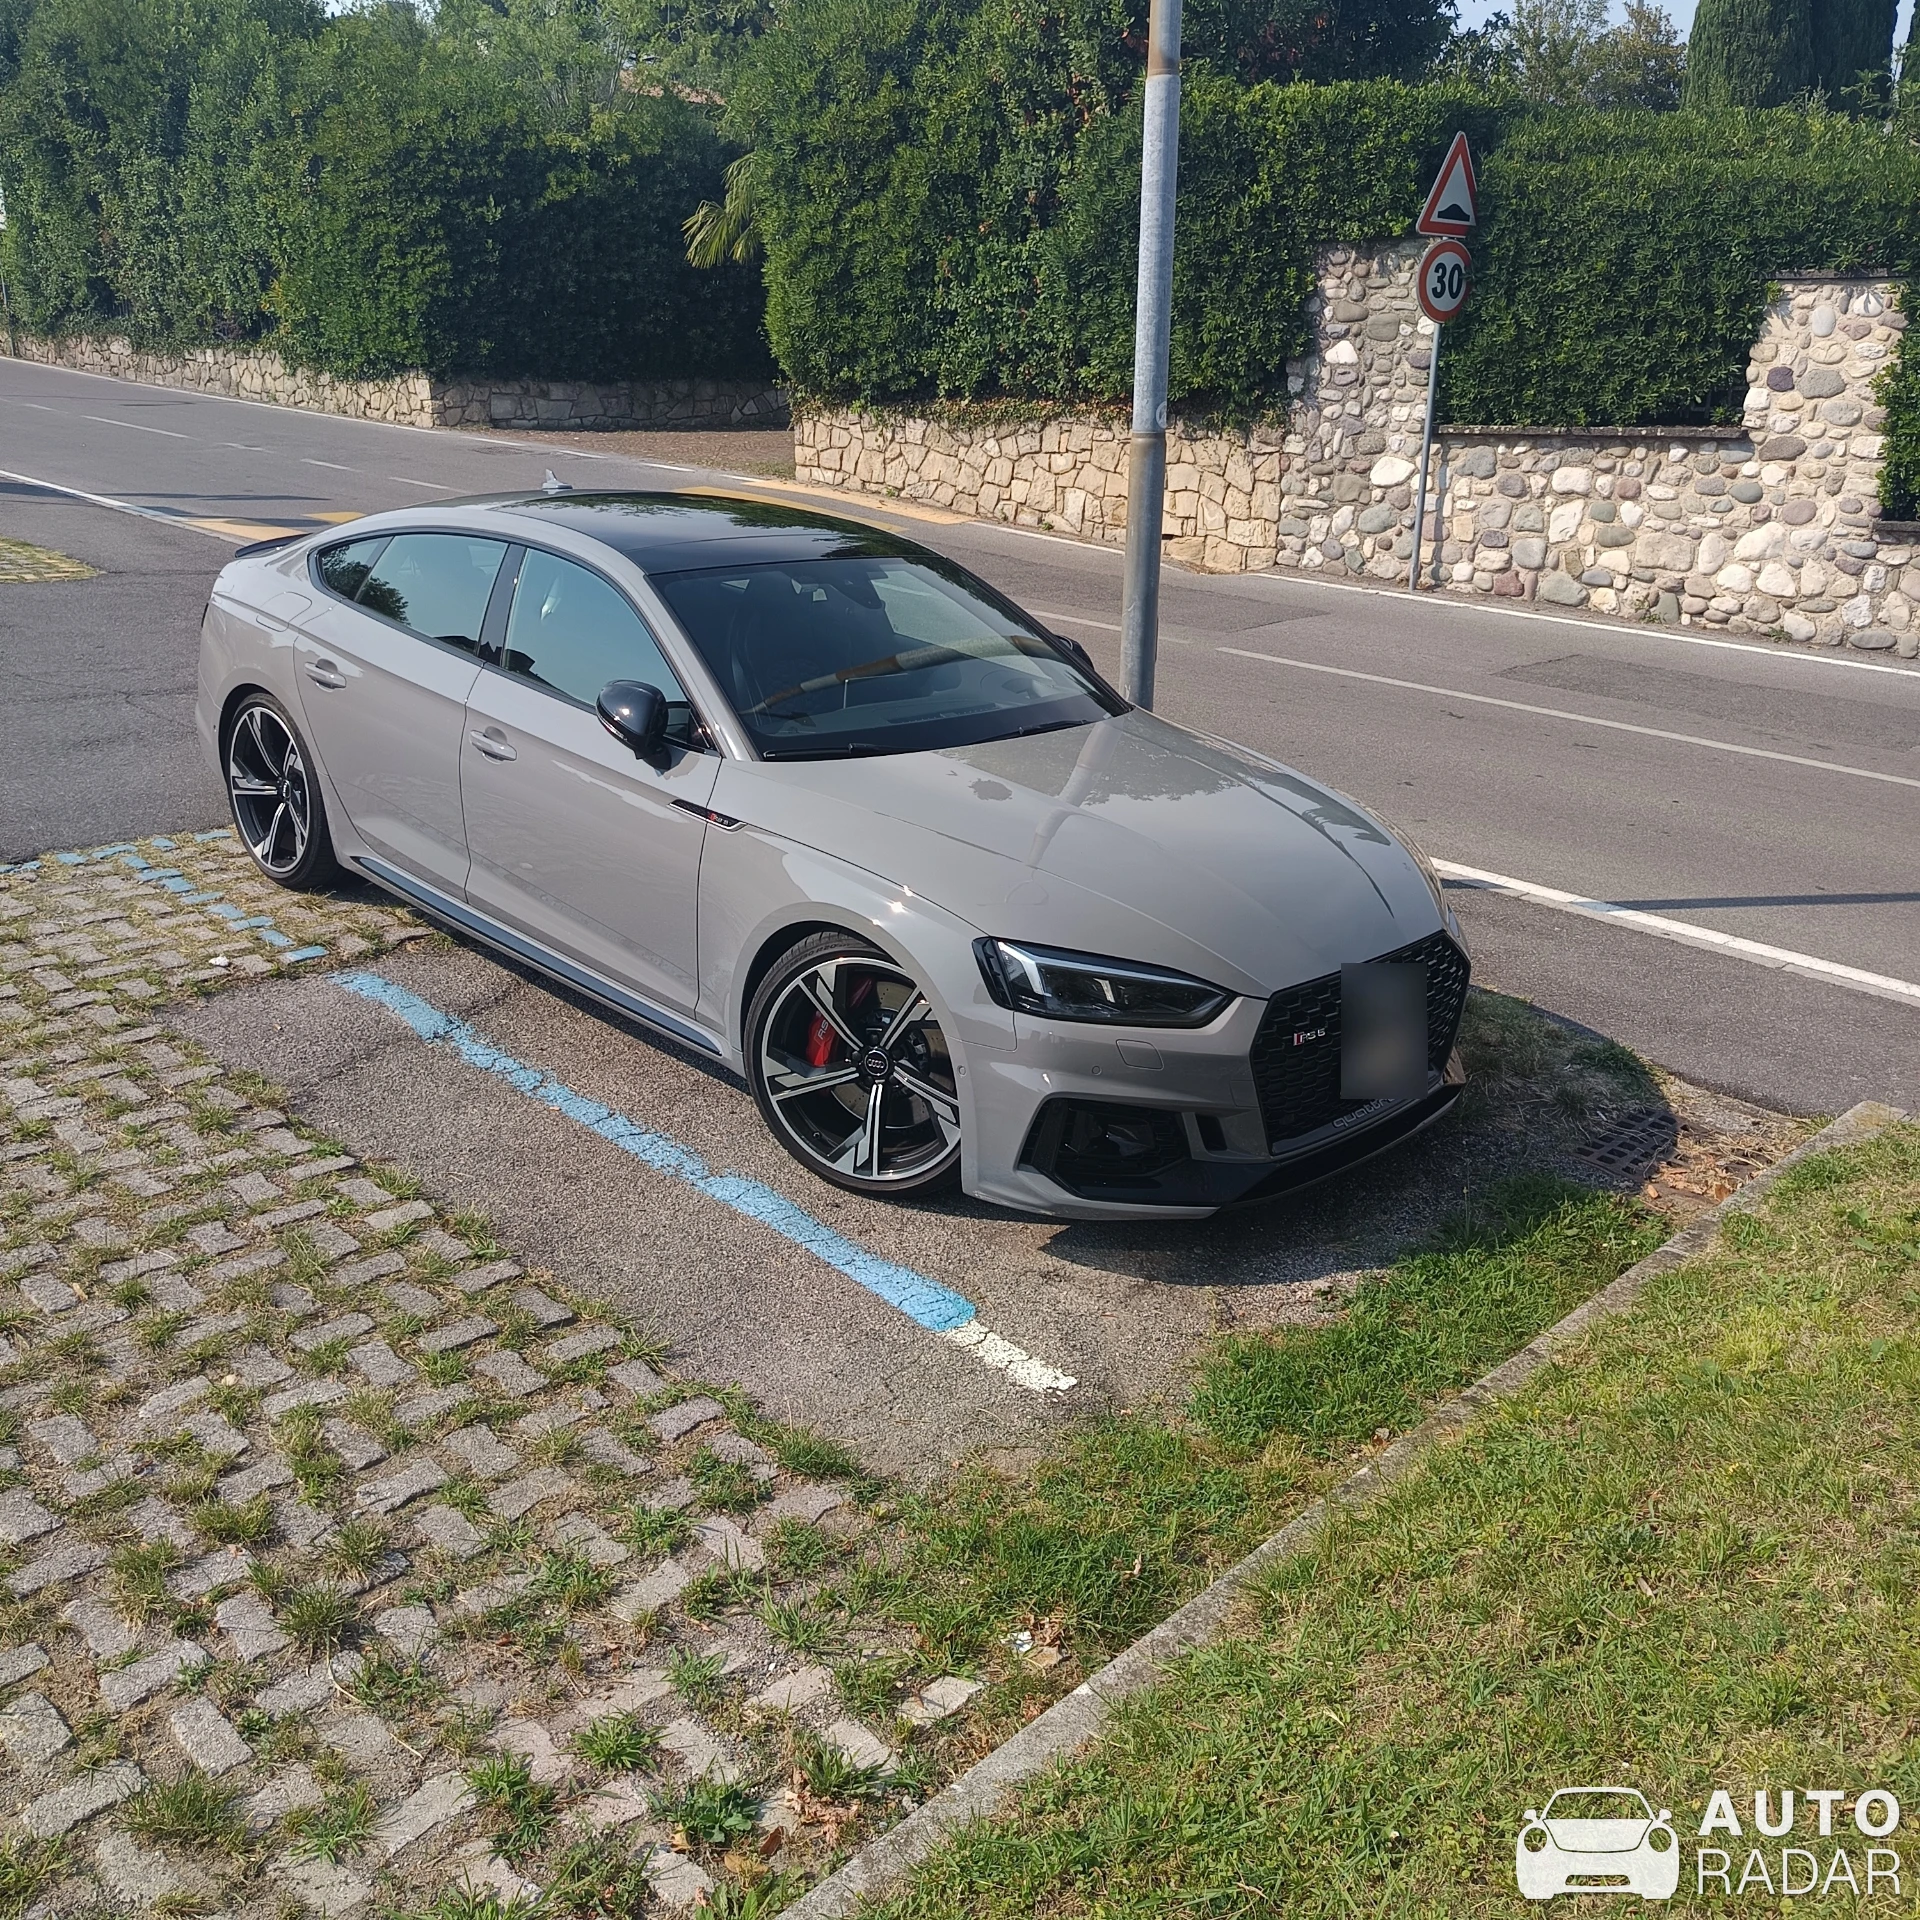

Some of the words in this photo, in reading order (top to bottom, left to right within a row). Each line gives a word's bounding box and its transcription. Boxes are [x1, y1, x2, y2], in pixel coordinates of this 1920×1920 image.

[1431, 262, 1463, 300] 30
[818, 1020, 829, 1040] RS
[1333, 1099, 1394, 1127] quattr
